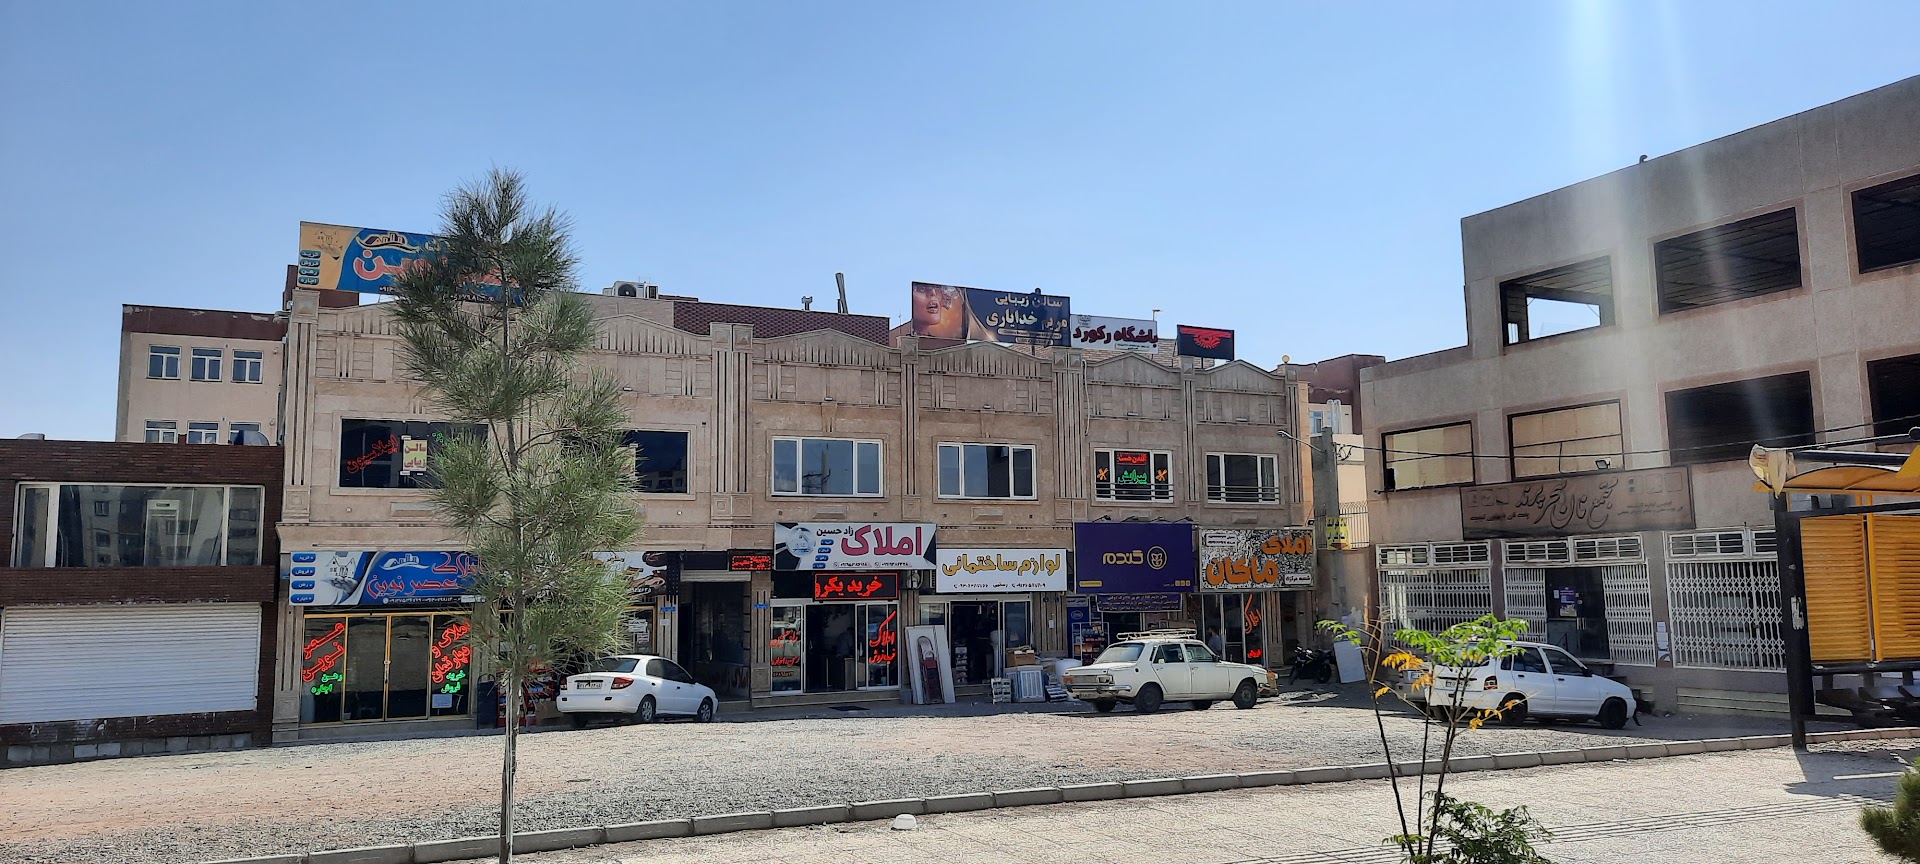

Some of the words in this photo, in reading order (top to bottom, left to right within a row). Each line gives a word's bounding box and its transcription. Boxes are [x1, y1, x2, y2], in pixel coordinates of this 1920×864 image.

[301, 259, 318, 267] فروش
[995, 293, 1030, 308] زیبایی
[1032, 296, 1063, 308] سالن
[986, 308, 1038, 327] خدایاری
[1041, 316, 1068, 331] مریم
[1072, 324, 1111, 344] رکورد
[1113, 325, 1159, 344] باشگاه
[816, 528, 842, 537] حسین
[841, 524, 922, 556] املاک
[843, 526, 854, 536] زاد
[1261, 535, 1312, 555] املاک
[942, 554, 1018, 576] ساختمانی
[1018, 554, 1061, 576] لوازم
[1103, 550, 1144, 565] گندم
[1206, 557, 1278, 586] ماکان
[366, 574, 404, 600] نوین
[404, 579, 460, 596] عصر
[847, 576, 883, 597] خرید
[869, 610, 896, 647] املاک
[303, 622, 346, 659] عصر
[302, 641, 345, 683] نوین
[321, 672, 342, 682] رهن
[311, 684, 333, 695] اجاره
